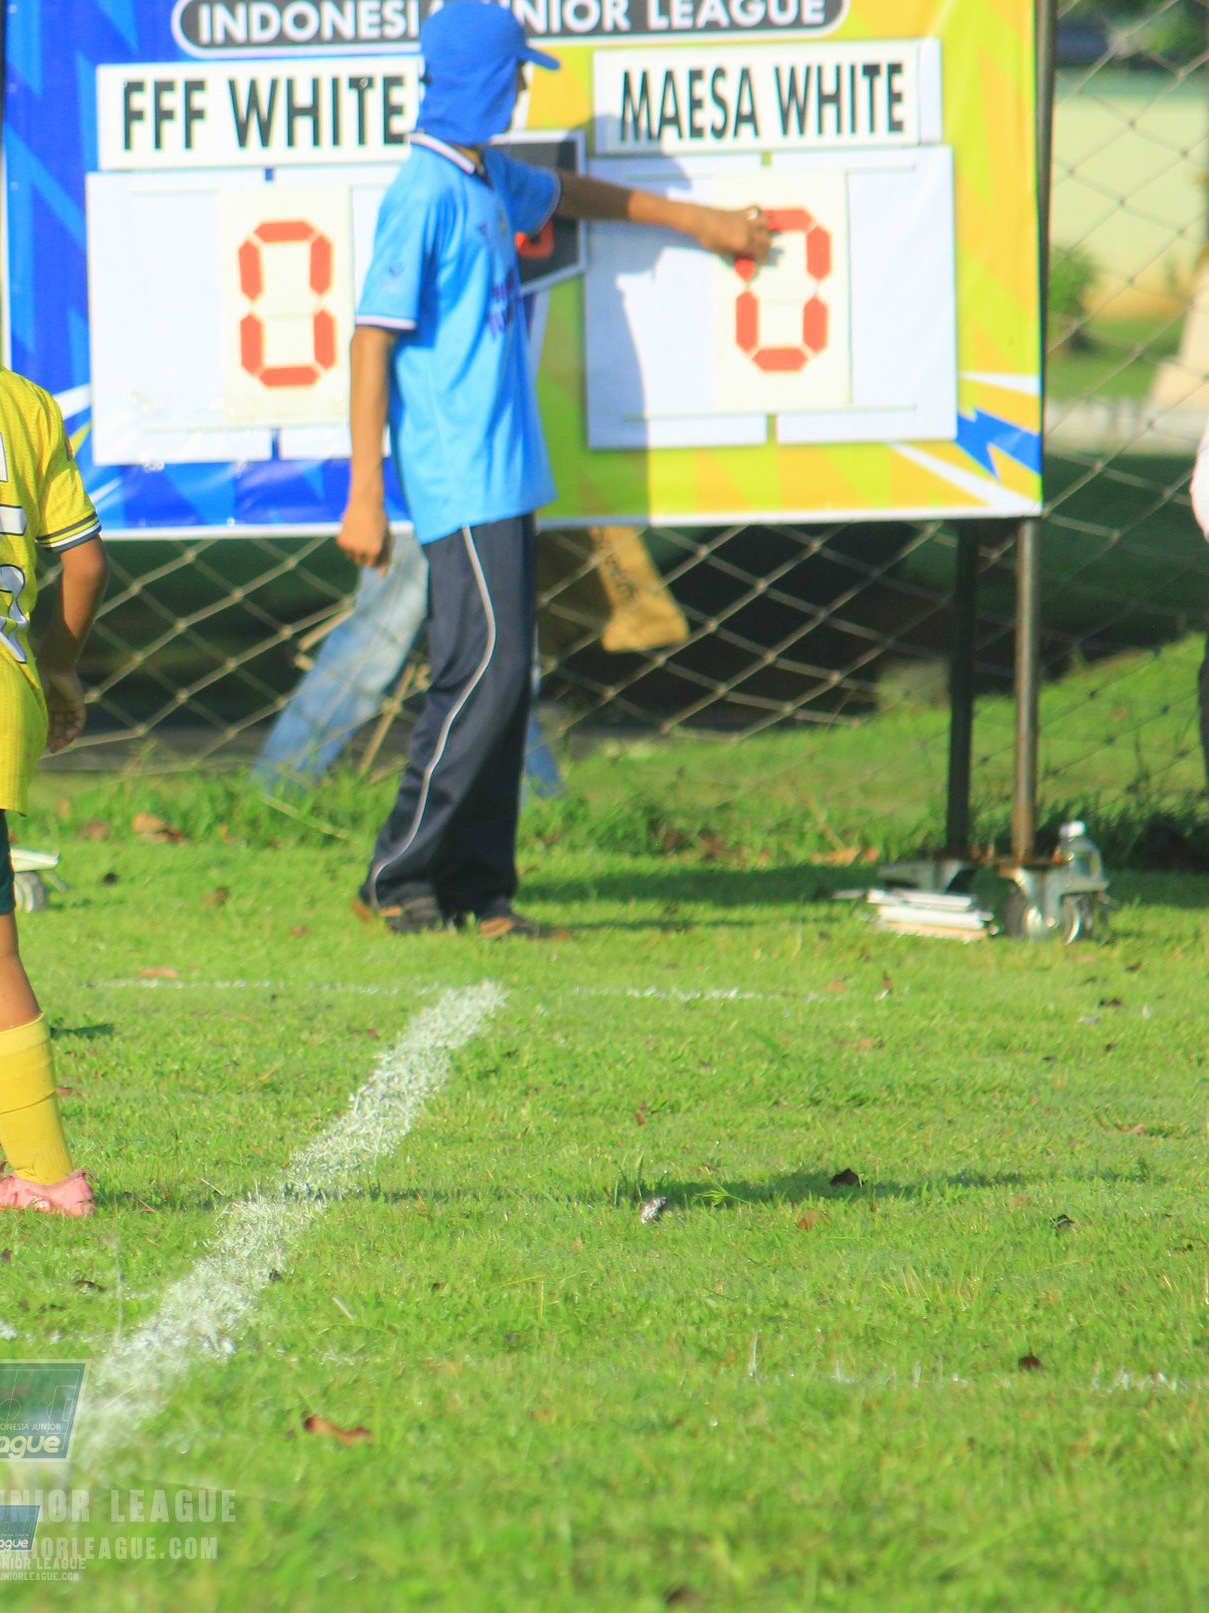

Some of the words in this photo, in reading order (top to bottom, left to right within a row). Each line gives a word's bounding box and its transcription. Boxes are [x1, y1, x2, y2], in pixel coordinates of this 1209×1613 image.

[198, 0, 444, 45] INDONESI
[647, 0, 827, 31] LEAGUE
[122, 79, 208, 152] FFF
[228, 74, 409, 149] WHITE
[619, 65, 760, 142] MAESA
[775, 61, 906, 138] WHITE
[237, 220, 337, 388] 0
[733, 207, 833, 375] 0
